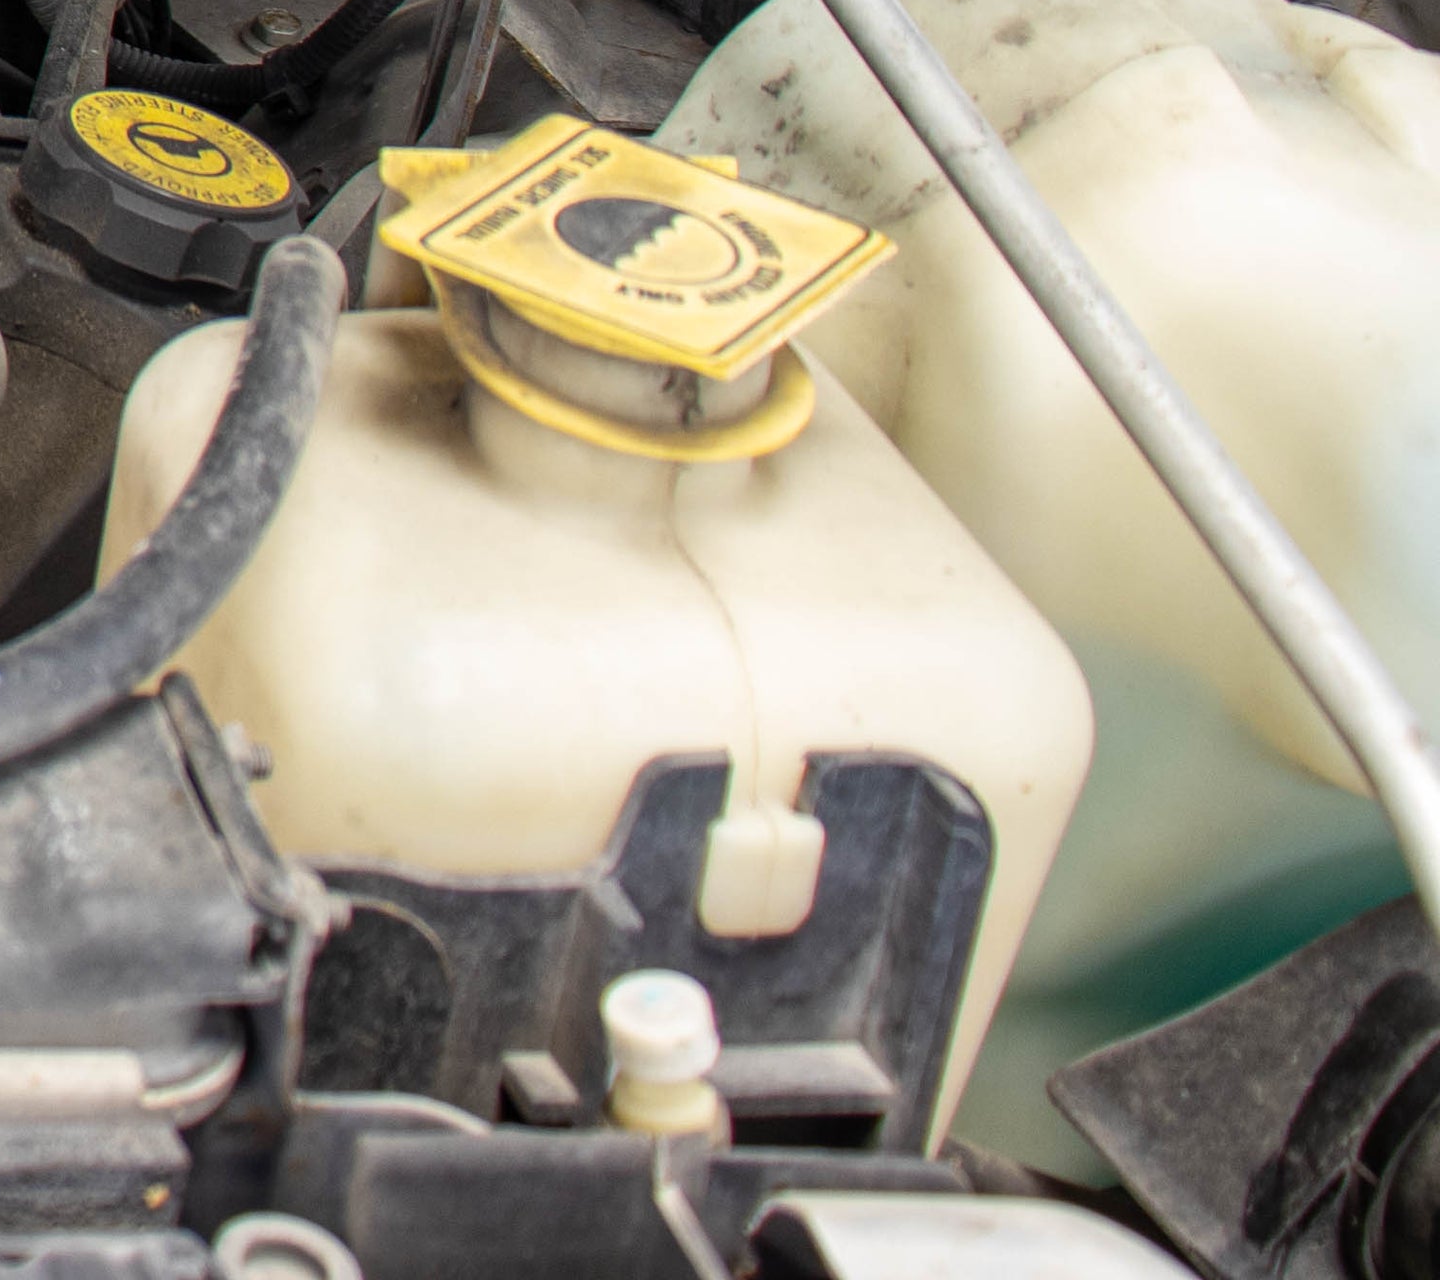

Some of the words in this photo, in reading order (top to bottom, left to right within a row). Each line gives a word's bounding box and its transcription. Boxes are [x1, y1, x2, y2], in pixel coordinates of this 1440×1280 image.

[73, 102, 101, 143] FLUID
[95, 92, 205, 123] STEERING
[218, 123, 273, 168] POWER
[122, 159, 242, 205] APPROVED
